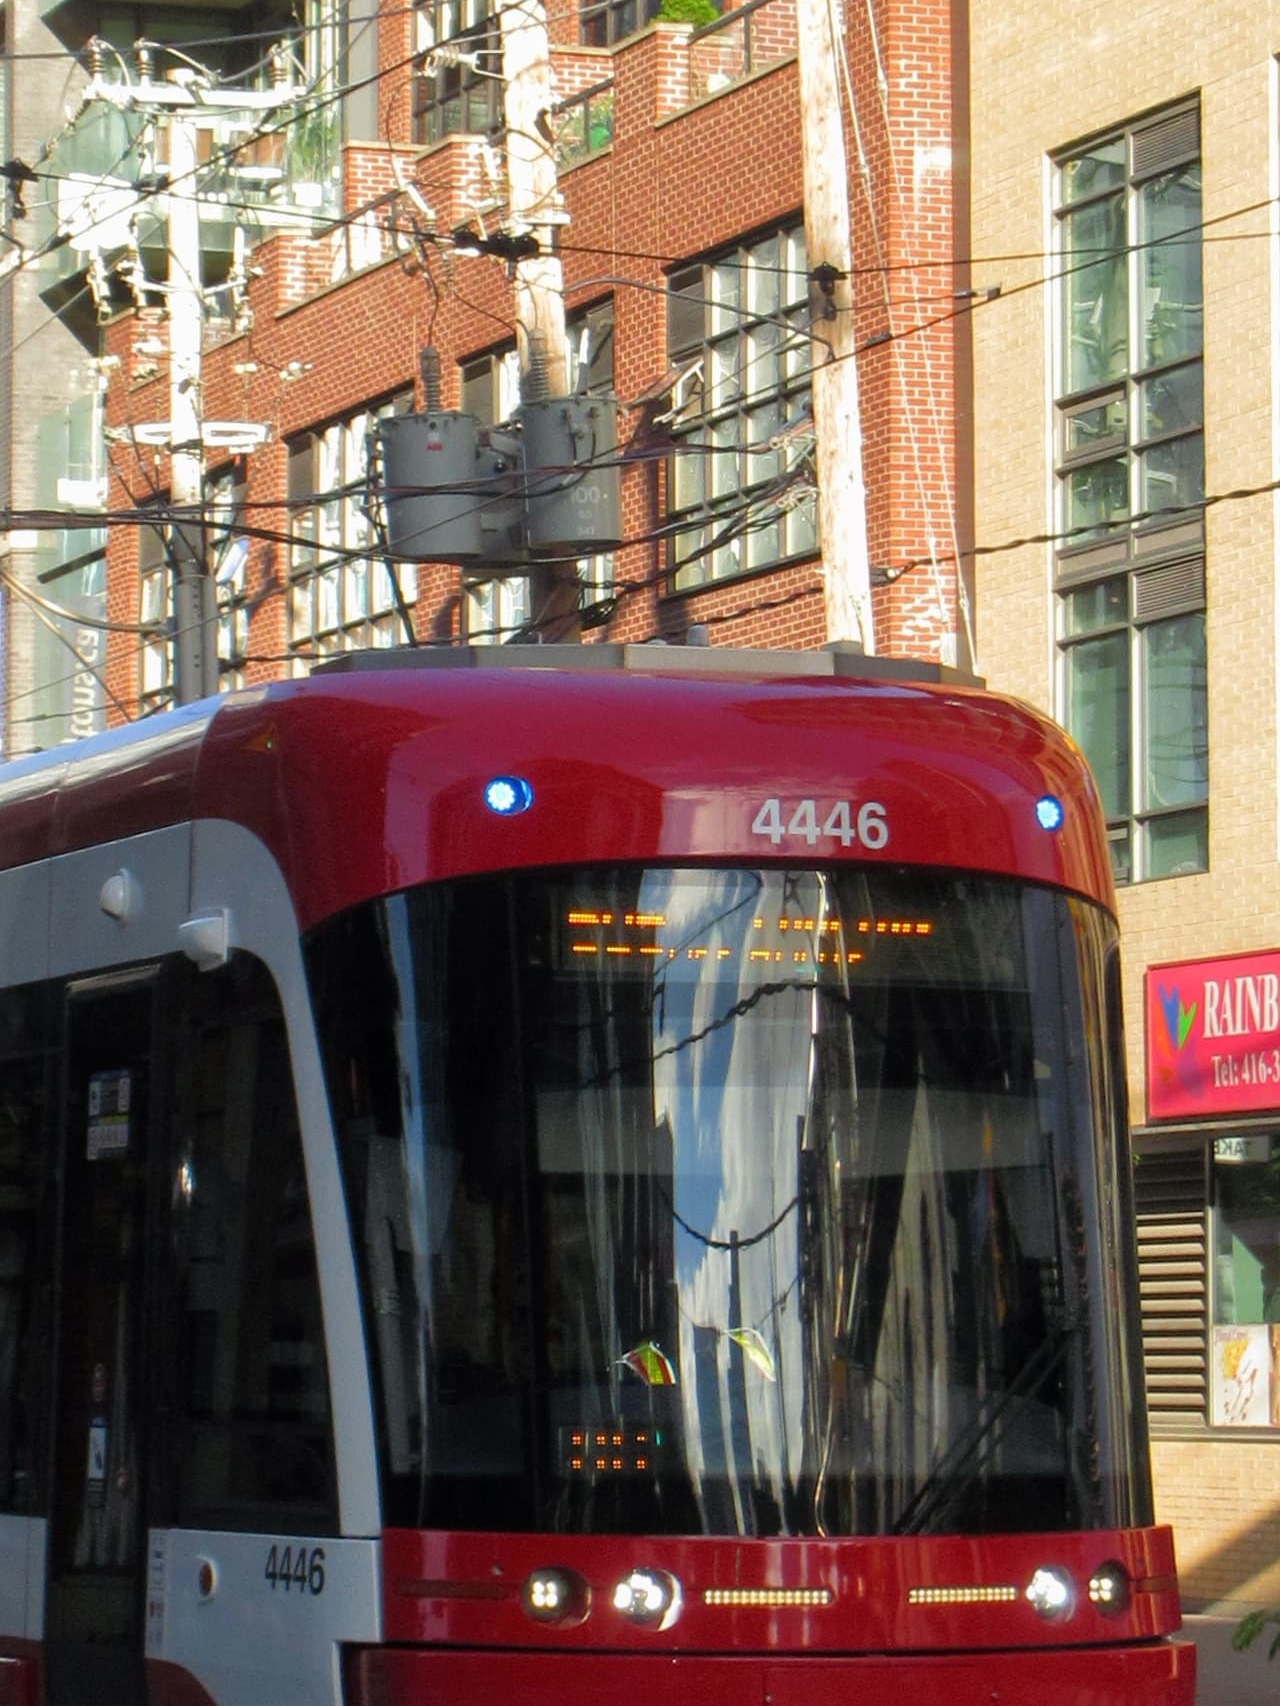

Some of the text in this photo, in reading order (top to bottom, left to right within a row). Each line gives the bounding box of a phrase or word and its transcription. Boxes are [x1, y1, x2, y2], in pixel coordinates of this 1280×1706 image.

[751, 798, 889, 850] 4446
[1211, 1054, 1240, 1088] Tel:
[265, 1545, 326, 1596] 4446
